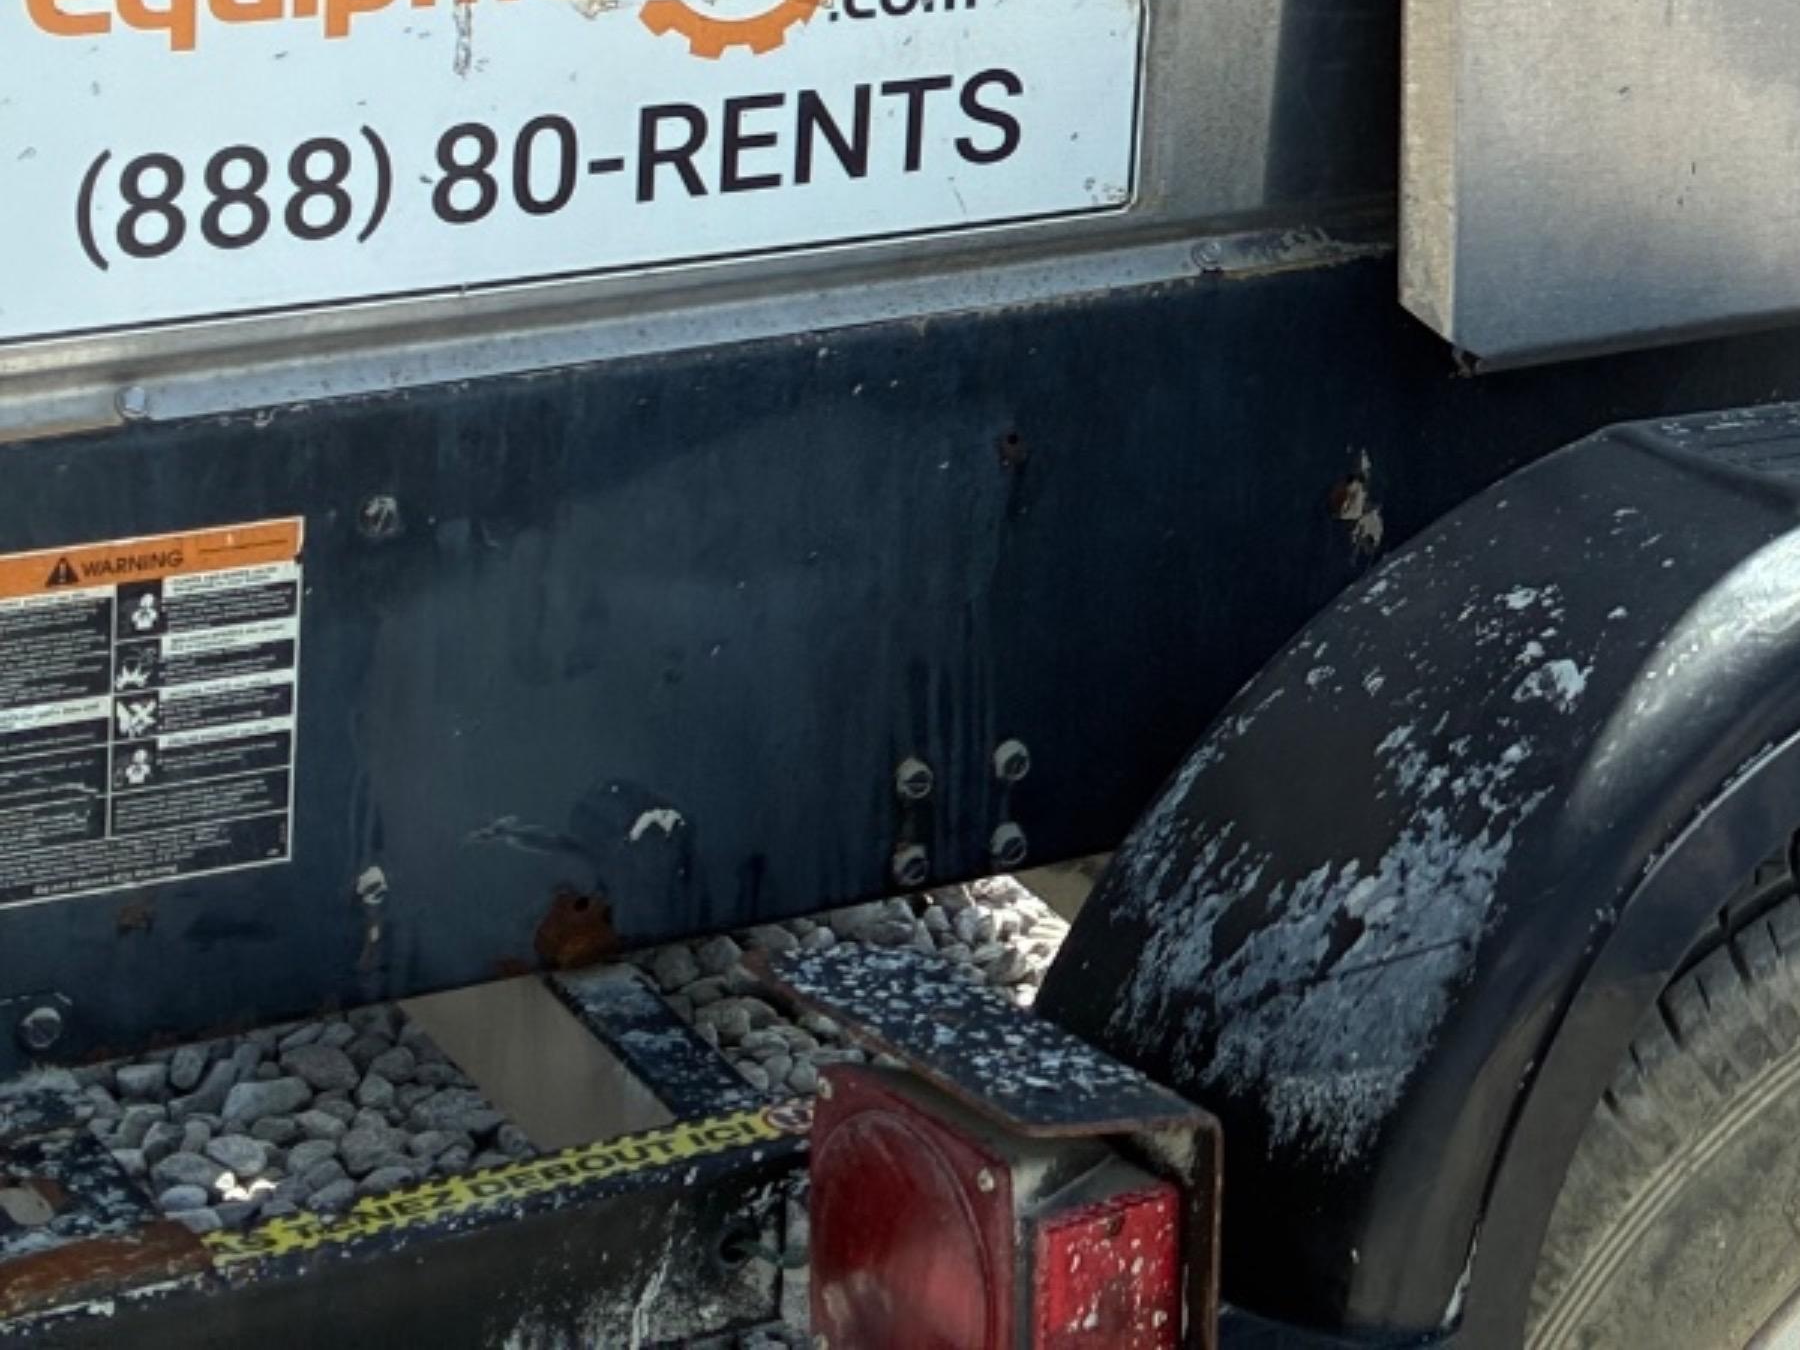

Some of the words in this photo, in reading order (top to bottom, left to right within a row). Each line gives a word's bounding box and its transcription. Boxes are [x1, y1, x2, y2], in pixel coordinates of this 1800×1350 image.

[76, 124, 392, 272] (888)
[430, 67, 1023, 225] 80-RENTS
[82, 550, 185, 578] WARNING
